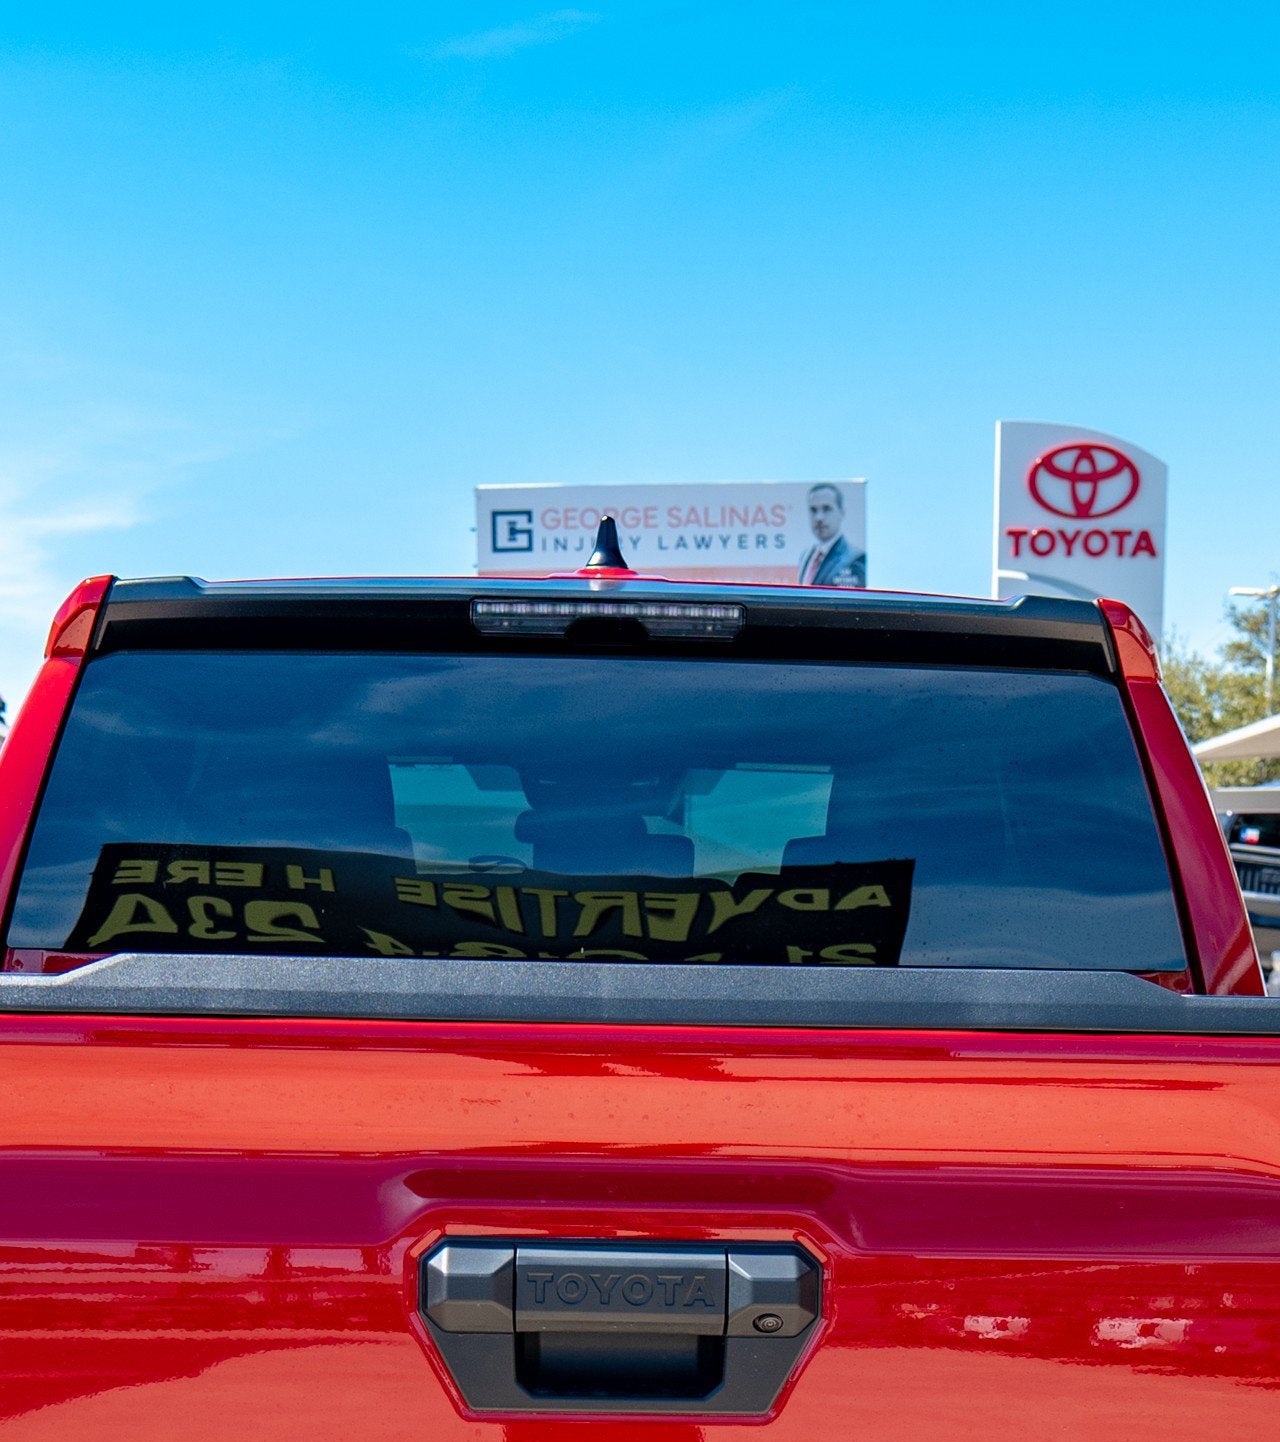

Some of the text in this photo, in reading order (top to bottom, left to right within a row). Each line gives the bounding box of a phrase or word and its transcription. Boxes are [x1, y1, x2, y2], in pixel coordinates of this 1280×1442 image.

[666, 503, 787, 528] SALINAS
[541, 532, 787, 552] INJY LAWYERS
[1006, 528, 1157, 557] TOYOTA
[526, 1271, 715, 1307] TOYOTA
